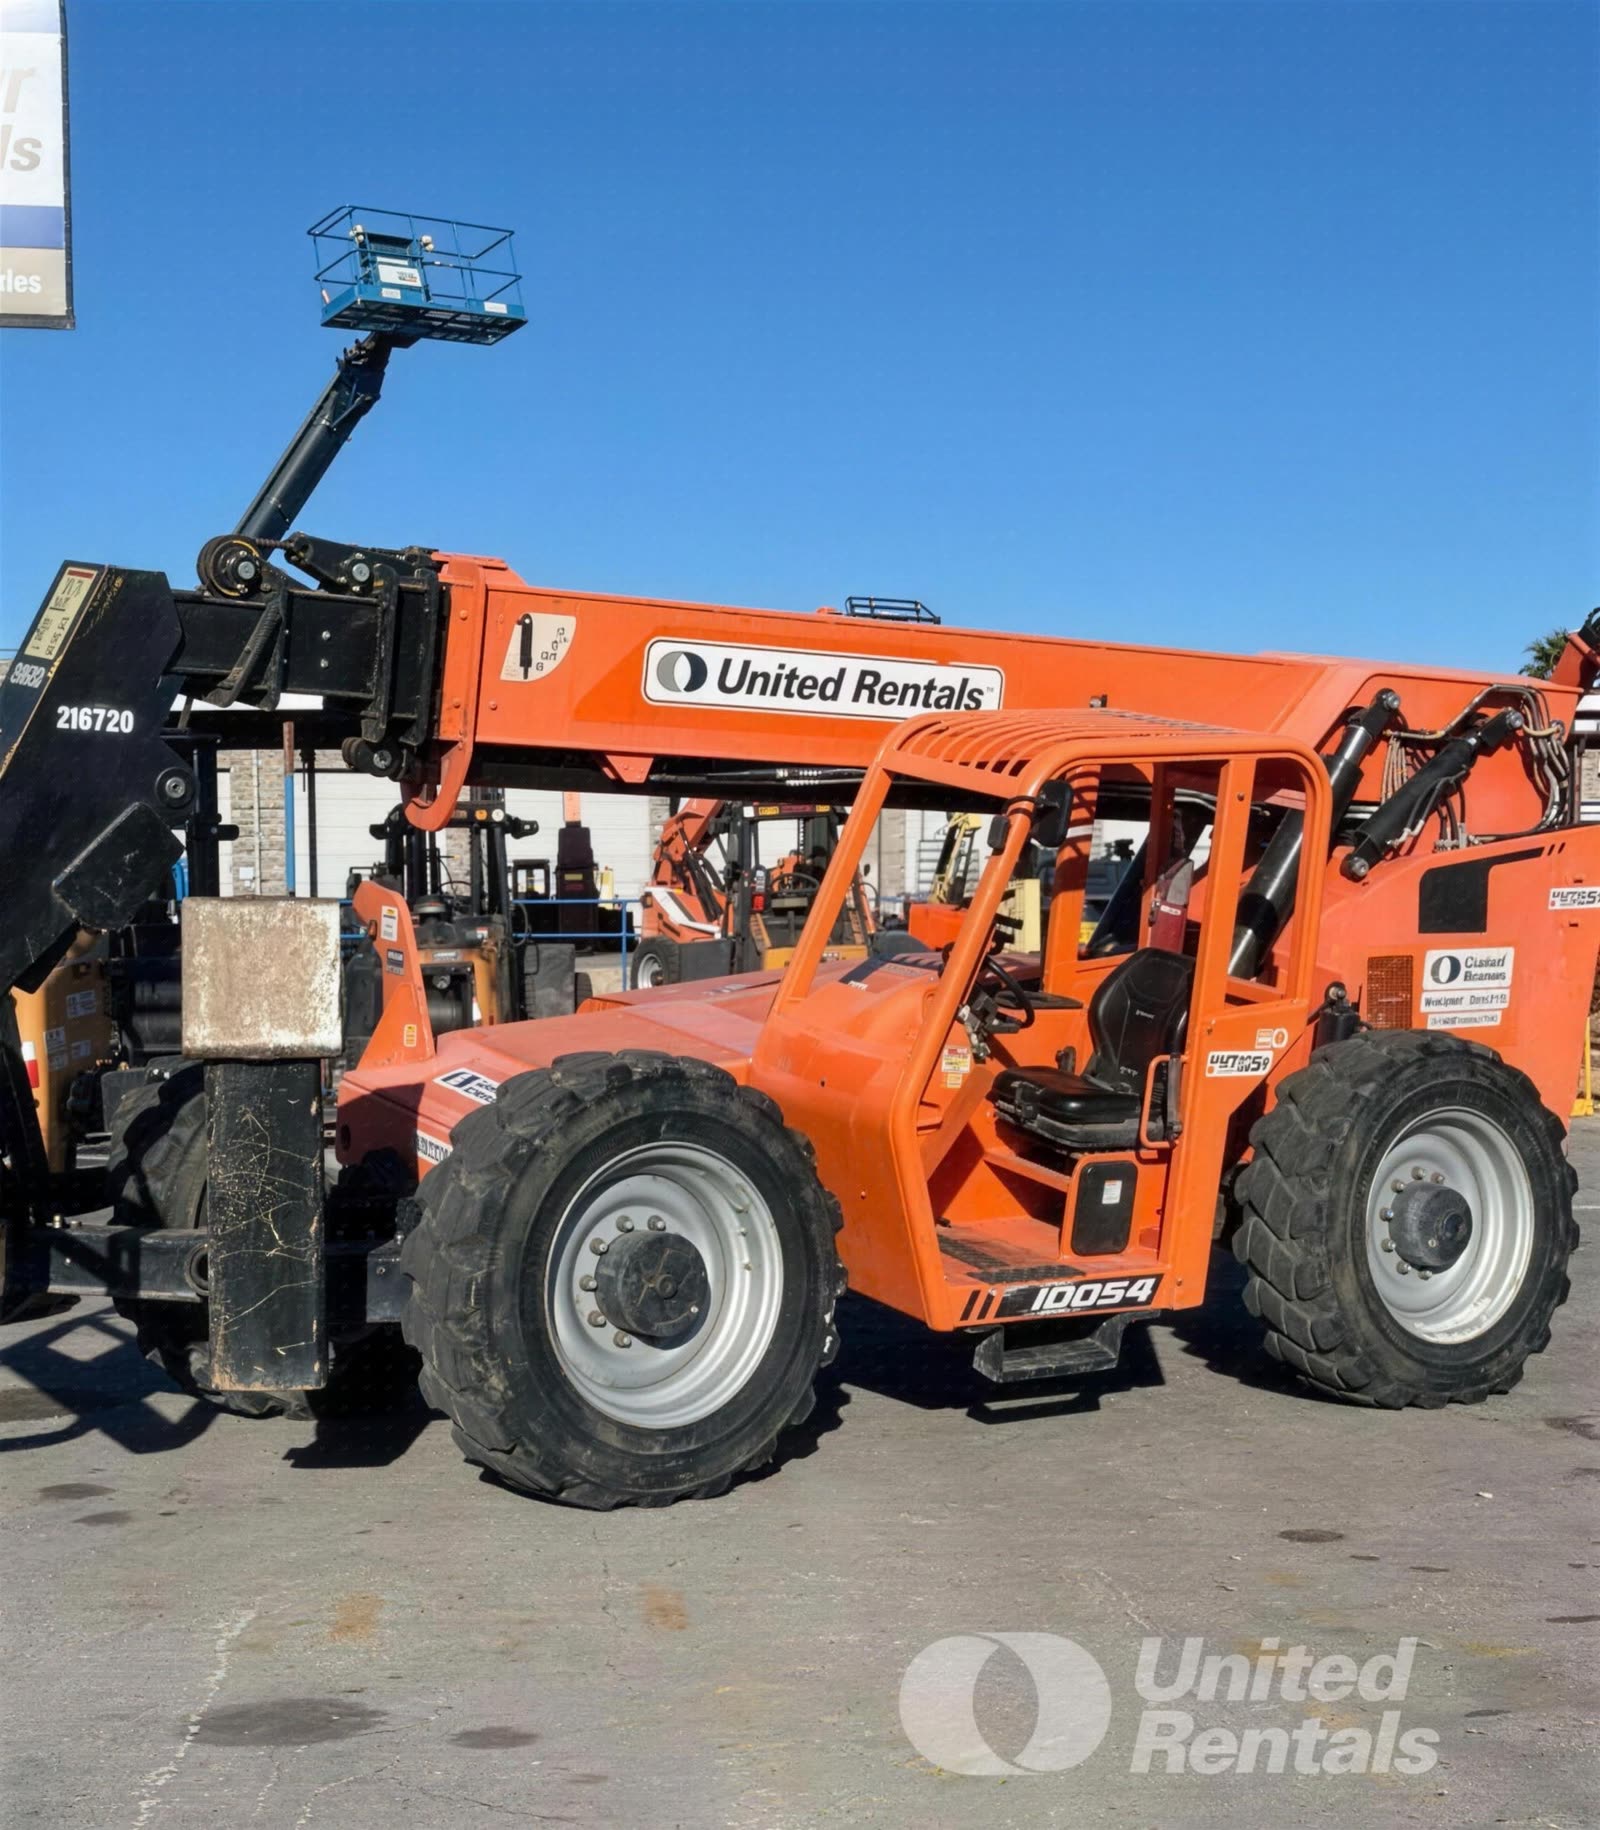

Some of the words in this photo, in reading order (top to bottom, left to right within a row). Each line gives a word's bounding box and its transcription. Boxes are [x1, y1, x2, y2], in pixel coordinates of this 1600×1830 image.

[717, 658, 847, 702] United
[851, 669, 985, 711] Rentals
[56, 705, 134, 733] 216720
[1031, 1278, 1156, 1311] 10054
